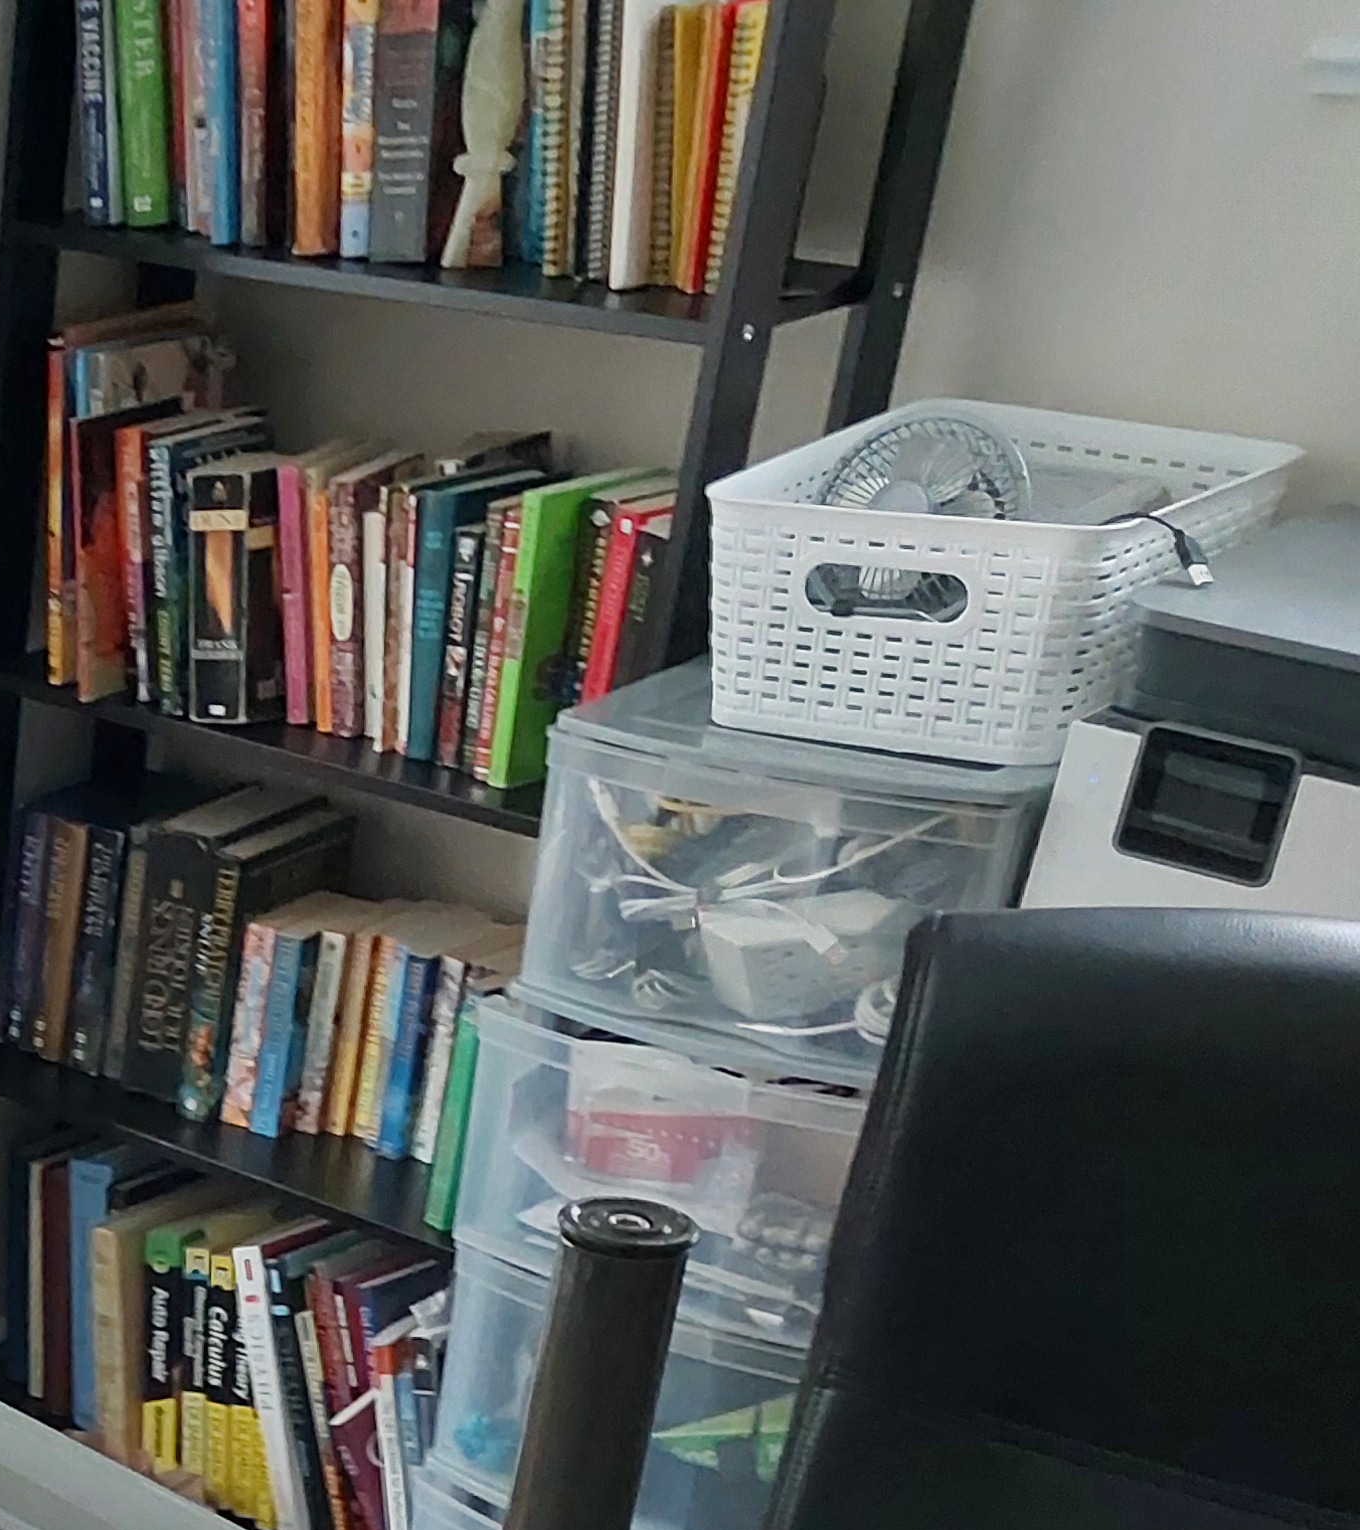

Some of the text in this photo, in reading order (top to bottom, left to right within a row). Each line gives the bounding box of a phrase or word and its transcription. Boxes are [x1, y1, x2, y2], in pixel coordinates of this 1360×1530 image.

[80, 17, 102, 105] VACCINE
[148, 1286, 171, 1384] Auto Repair
[206, 1307, 230, 1388] Calculus
[232, 1347, 248, 1400] Theory
